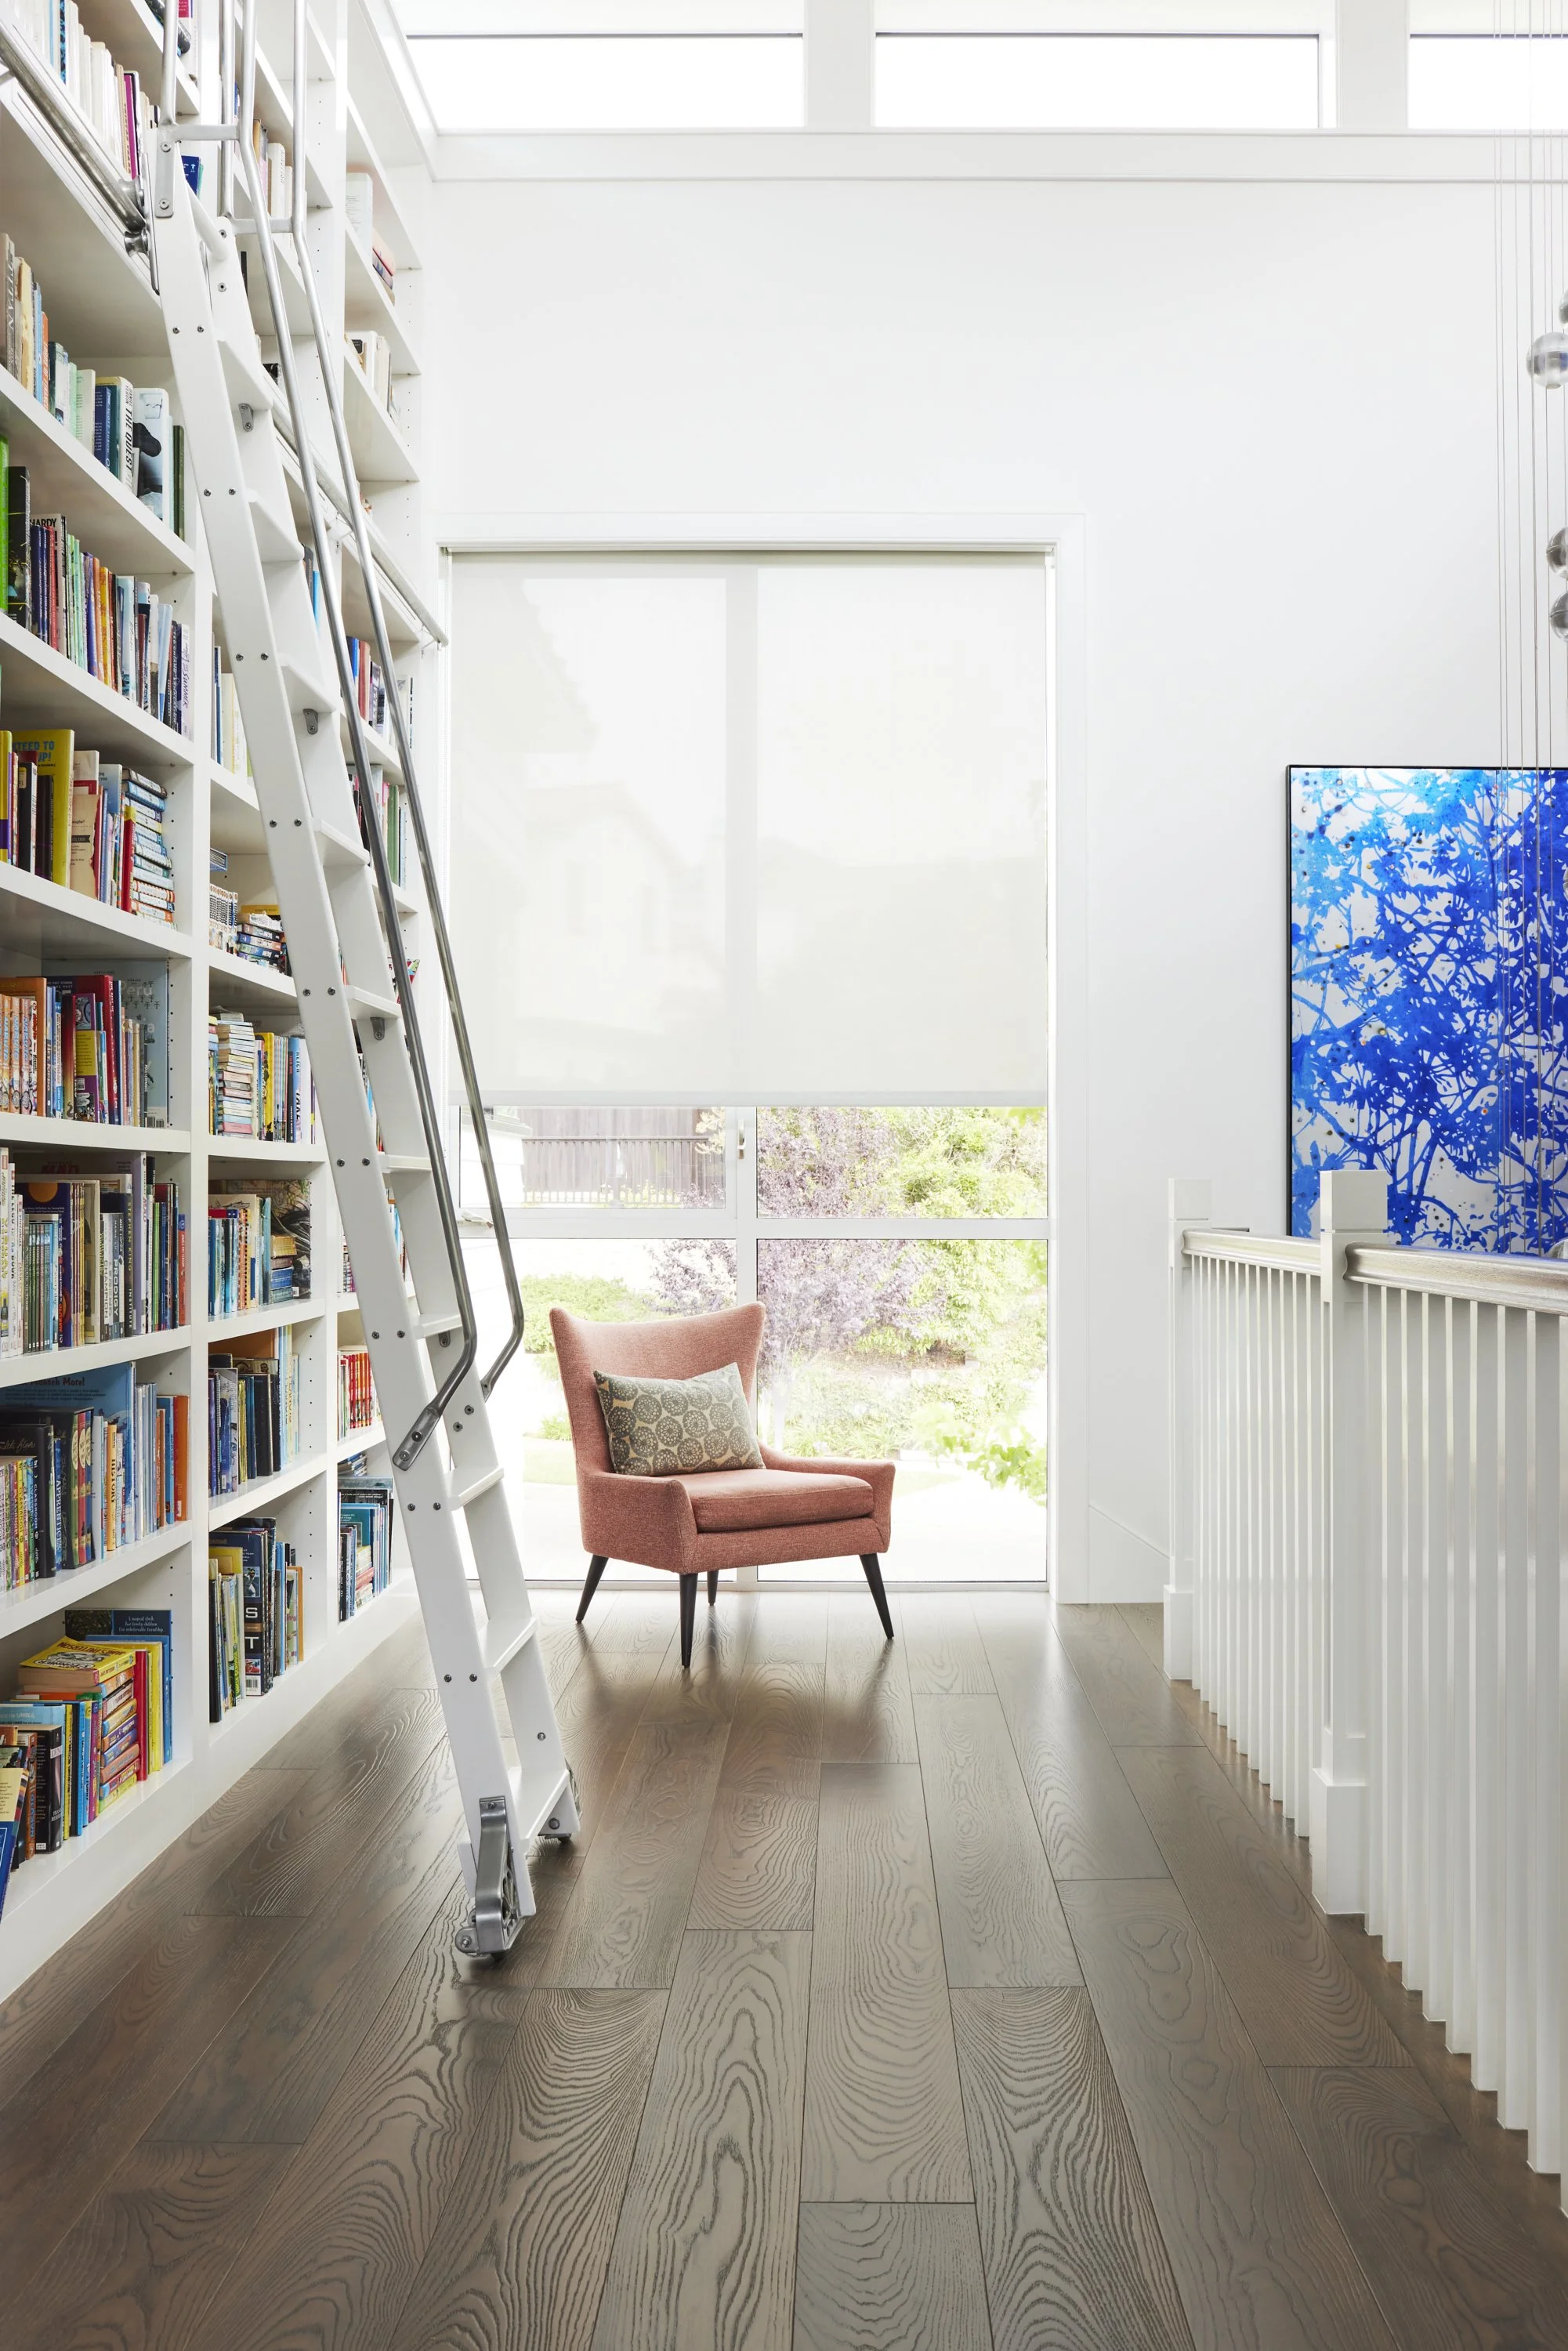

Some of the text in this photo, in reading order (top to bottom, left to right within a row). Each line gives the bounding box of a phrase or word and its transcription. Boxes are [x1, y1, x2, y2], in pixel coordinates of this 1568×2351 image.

[30, 518, 57, 528] HARDY
[44, 741, 55, 750] TO
[121, 981, 153, 996] Peru
[63, 1377, 85, 1386] More!
[56, 1642, 100, 1654] PATTERSON
